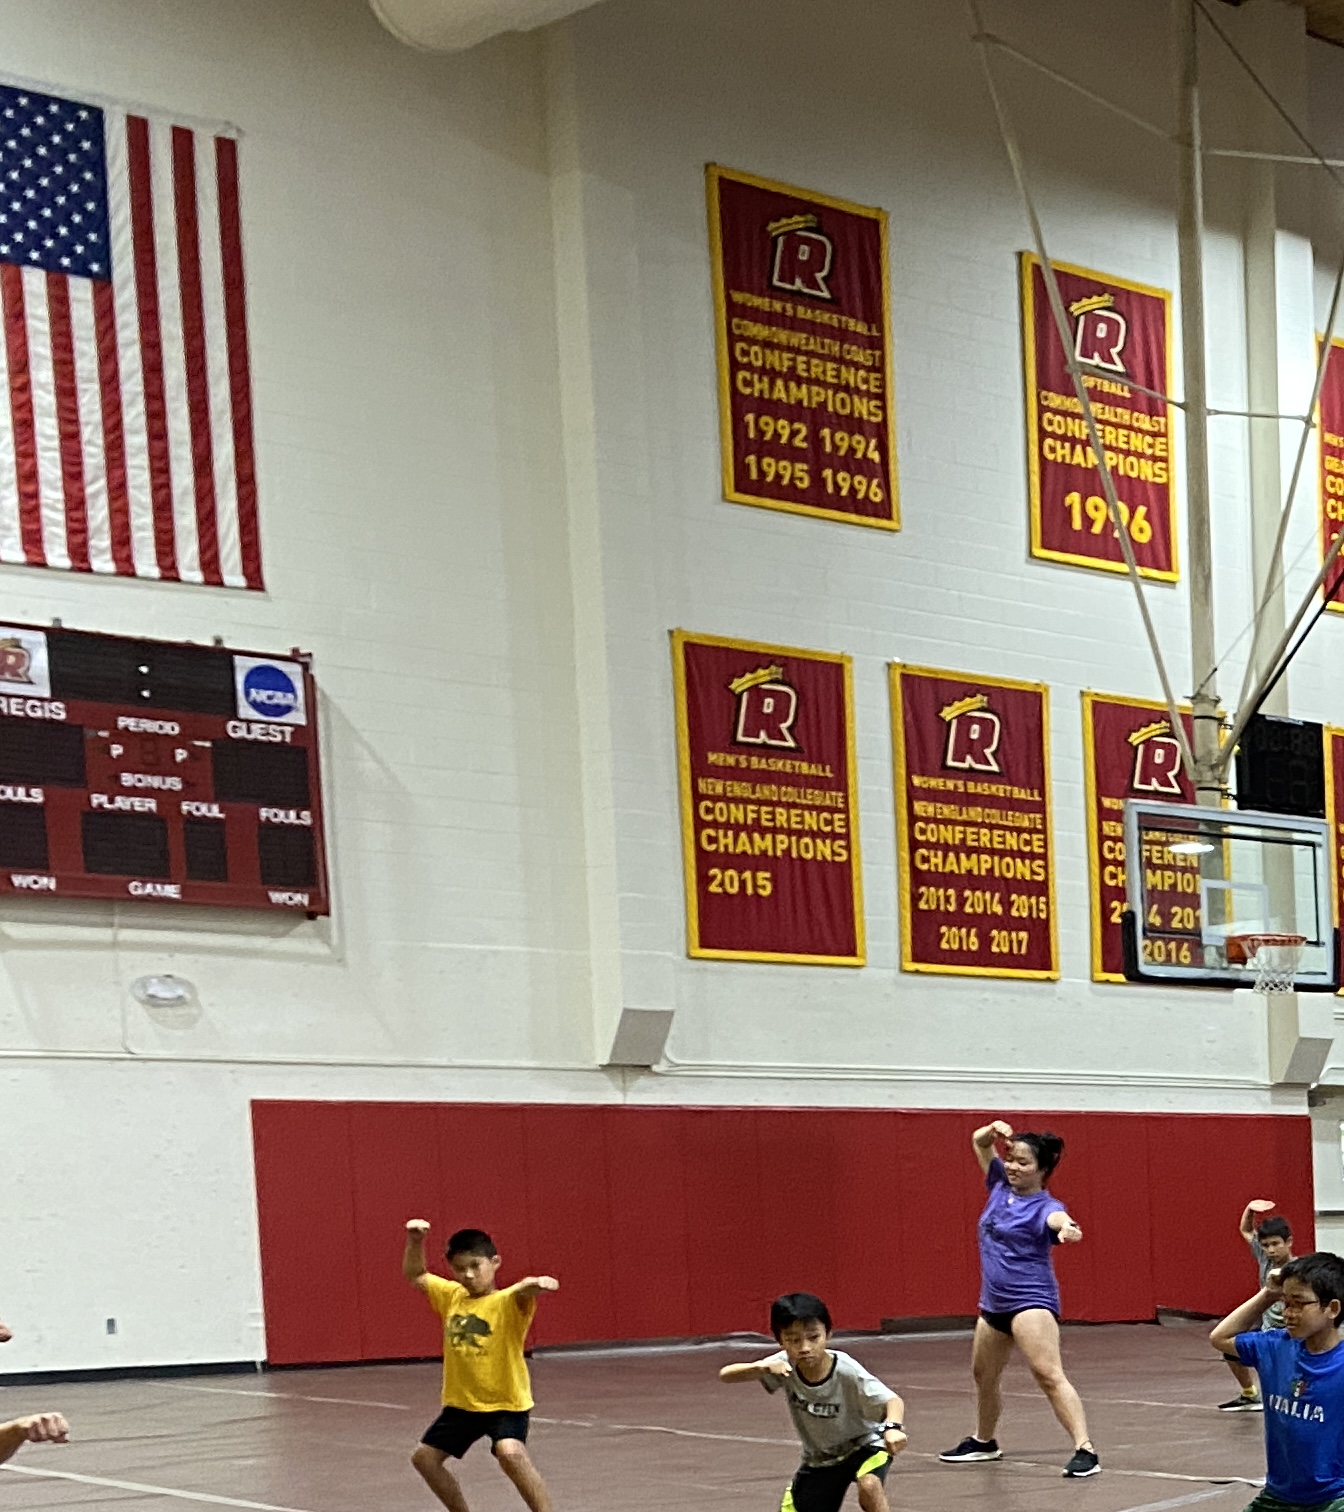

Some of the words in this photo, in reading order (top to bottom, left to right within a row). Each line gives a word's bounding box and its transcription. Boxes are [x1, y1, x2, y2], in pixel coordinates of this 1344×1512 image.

[772, 230, 832, 299] R
[842, 344, 882, 366] COAST
[1074, 309, 1126, 373] R
[734, 342, 883, 393] CONFERENCE
[735, 370, 883, 422] CHAMPIONS
[1080, 374, 1132, 398] OFTBALL
[1132, 411, 1166, 434] COAST
[744, 413, 808, 449] 1992
[819, 427, 881, 464] 1994
[745, 454, 811, 489] 1995
[821, 468, 883, 503] 1996
[117, 716, 180, 736] PERIOD
[737, 683, 798, 748] R
[226, 720, 295, 743] GUEST
[946, 711, 1000, 772] R
[707, 751, 748, 768] MEN'S
[750, 756, 834, 778] BASKETBALL
[1133, 736, 1182, 795] R
[0, 785, 44, 803] OULS
[120, 772, 182, 792] BONUS
[698, 776, 724, 796] NEW
[725, 780, 779, 801] ENGLAND
[780, 786, 846, 809] COLLEGIATE
[912, 774, 965, 792] WOMEN'S
[966, 781, 1042, 801] BASKETBALL
[90, 793, 157, 813] PLAYER
[181, 801, 225, 819] FOUL
[259, 807, 312, 826] FOULS
[699, 800, 847, 834] CONFERENCE
[701, 828, 849, 863] CHAMPIONS
[914, 821, 1045, 854] CONFERENCE
[915, 848, 1046, 881] CHAMPIONS
[1103, 840, 1199, 868] COFEREN
[11, 873, 56, 892] WON
[128, 881, 182, 900] GAME
[708, 868, 773, 897] 2015
[1104, 865, 1201, 895] CHMPIO
[268, 890, 310, 908] WON
[918, 886, 957, 912] 2013
[963, 889, 1003, 915] 2014
[1010, 893, 1047, 919] 2015
[940, 925, 979, 951] 2016
[990, 929, 1029, 955] 2017
[1142, 939, 1192, 964] 2016
[1269, 1394, 1325, 1423] ITALIA
